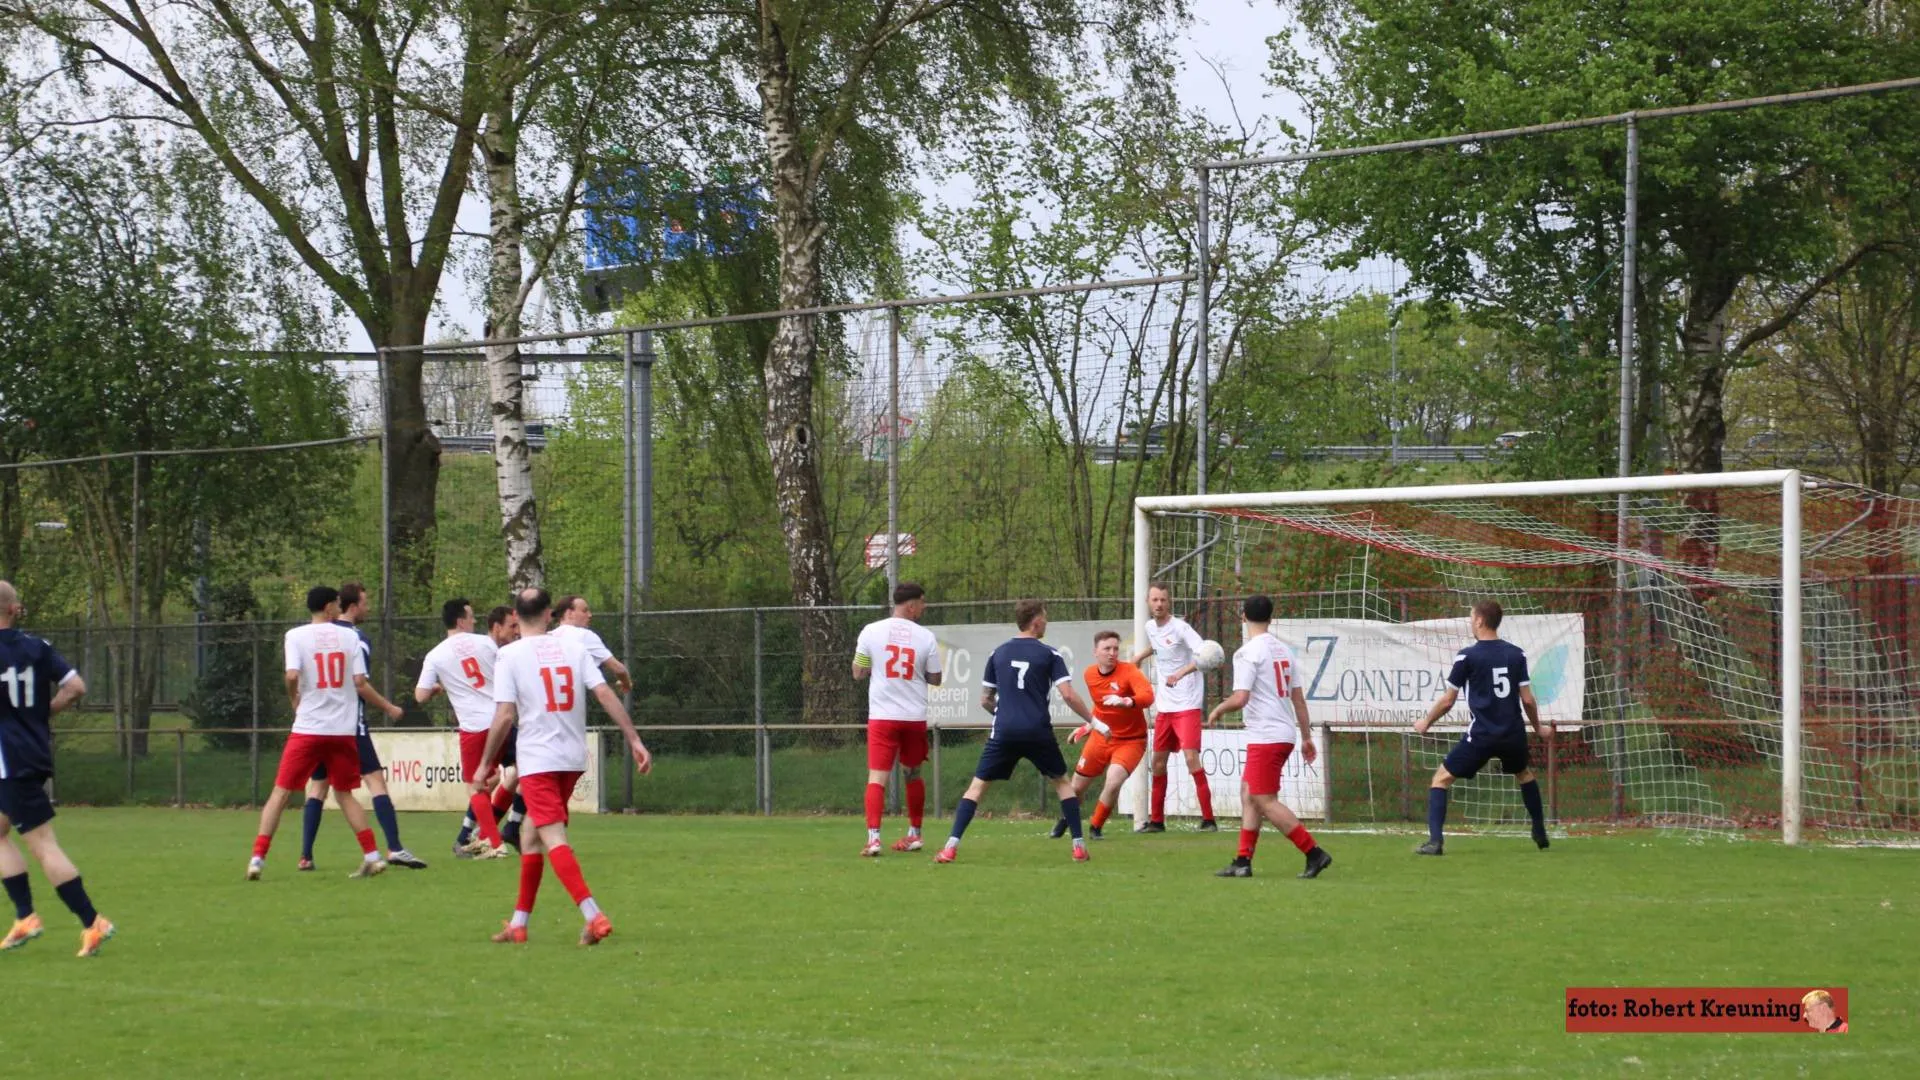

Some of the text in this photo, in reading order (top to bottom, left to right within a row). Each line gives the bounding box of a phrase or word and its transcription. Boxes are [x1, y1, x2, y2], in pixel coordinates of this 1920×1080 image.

[314, 652, 345, 689] 10
[461, 656, 486, 689] 9
[884, 645, 916, 680] 23
[1011, 660, 1030, 690] 7
[1306, 635, 1466, 702] ZONNEPA
[0, 664, 36, 708] 11
[540, 666, 575, 712] 13
[1492, 667, 1511, 699] 5
[392, 760, 422, 783] HVC
[425, 761, 465, 789] groet
